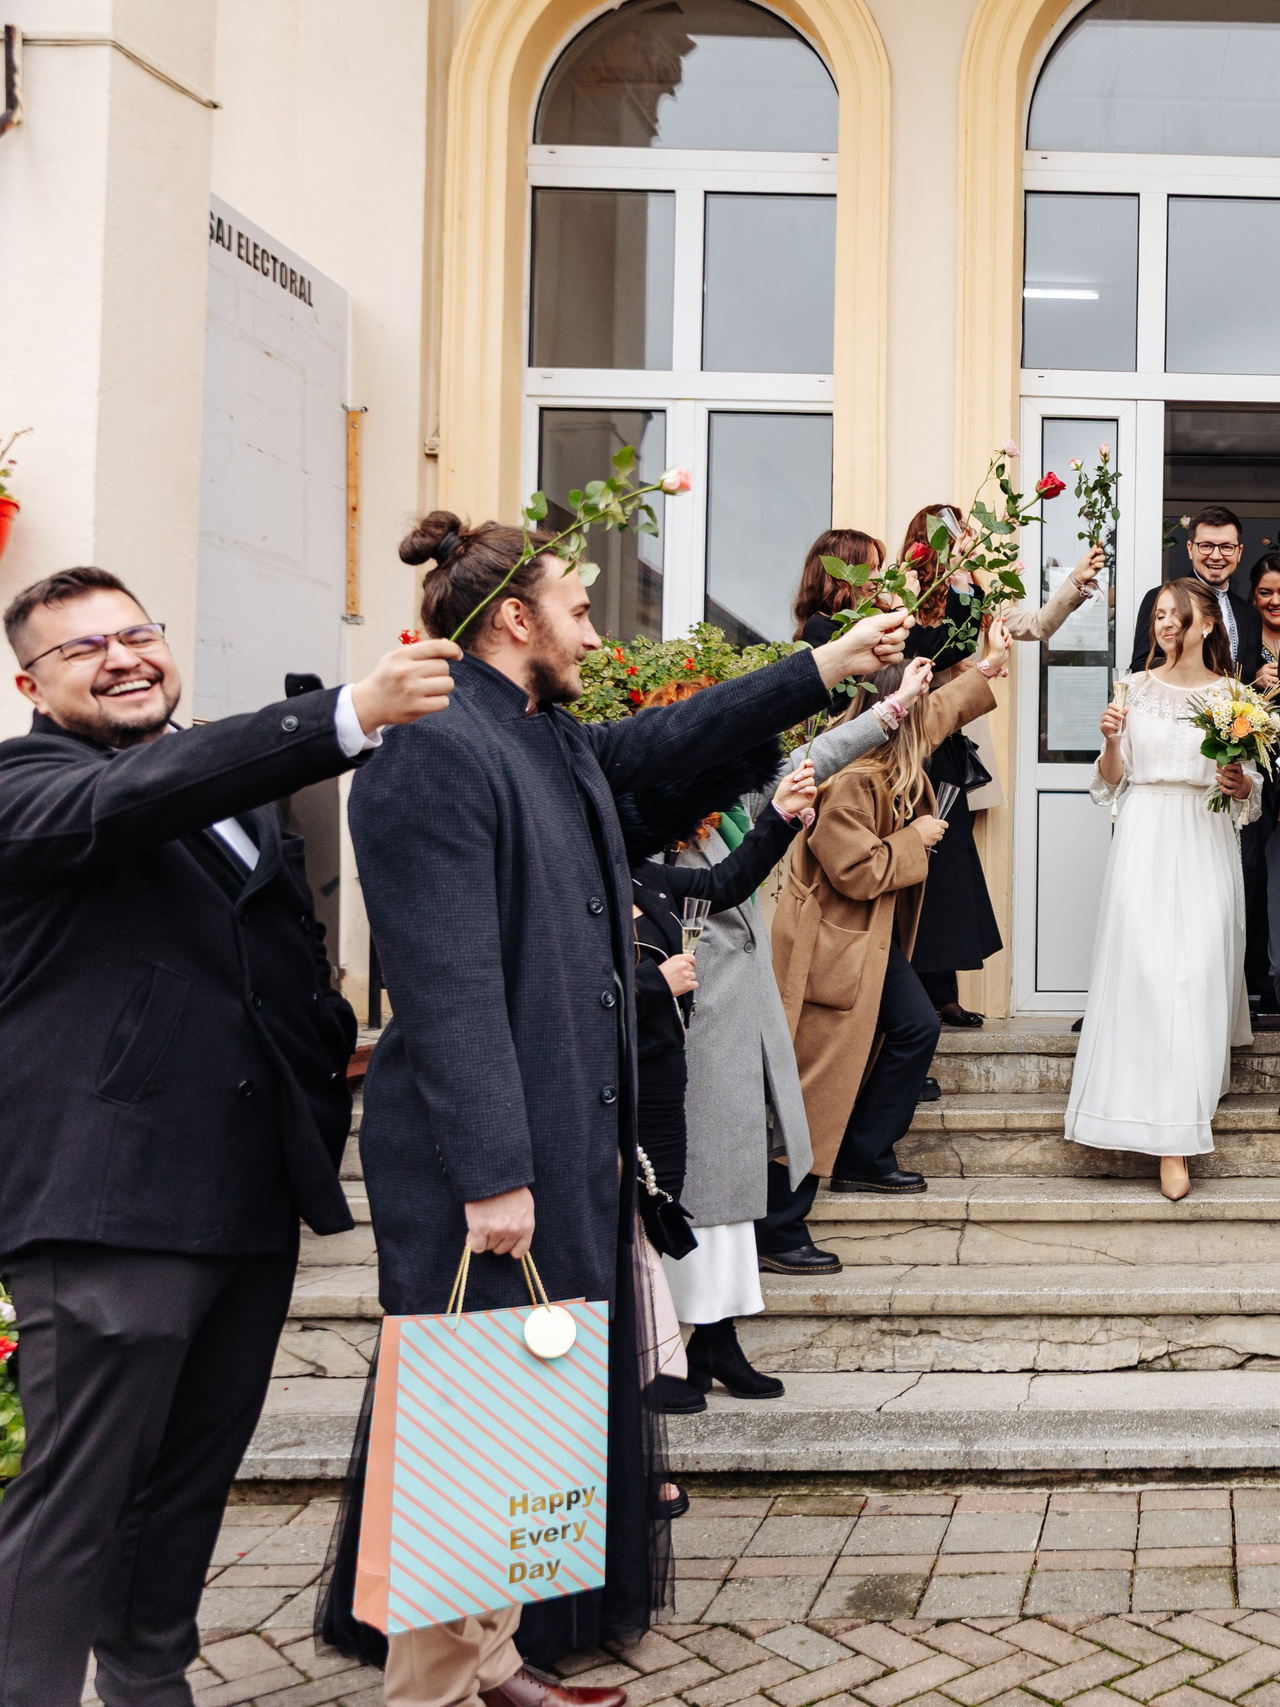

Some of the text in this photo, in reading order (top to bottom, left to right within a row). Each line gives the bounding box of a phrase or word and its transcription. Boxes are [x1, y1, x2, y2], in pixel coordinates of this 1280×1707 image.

[238, 231, 313, 308] ELECTORAL
[509, 1484, 597, 1517] Happy
[509, 1518, 588, 1551] Every
[508, 1557, 561, 1584] Day
